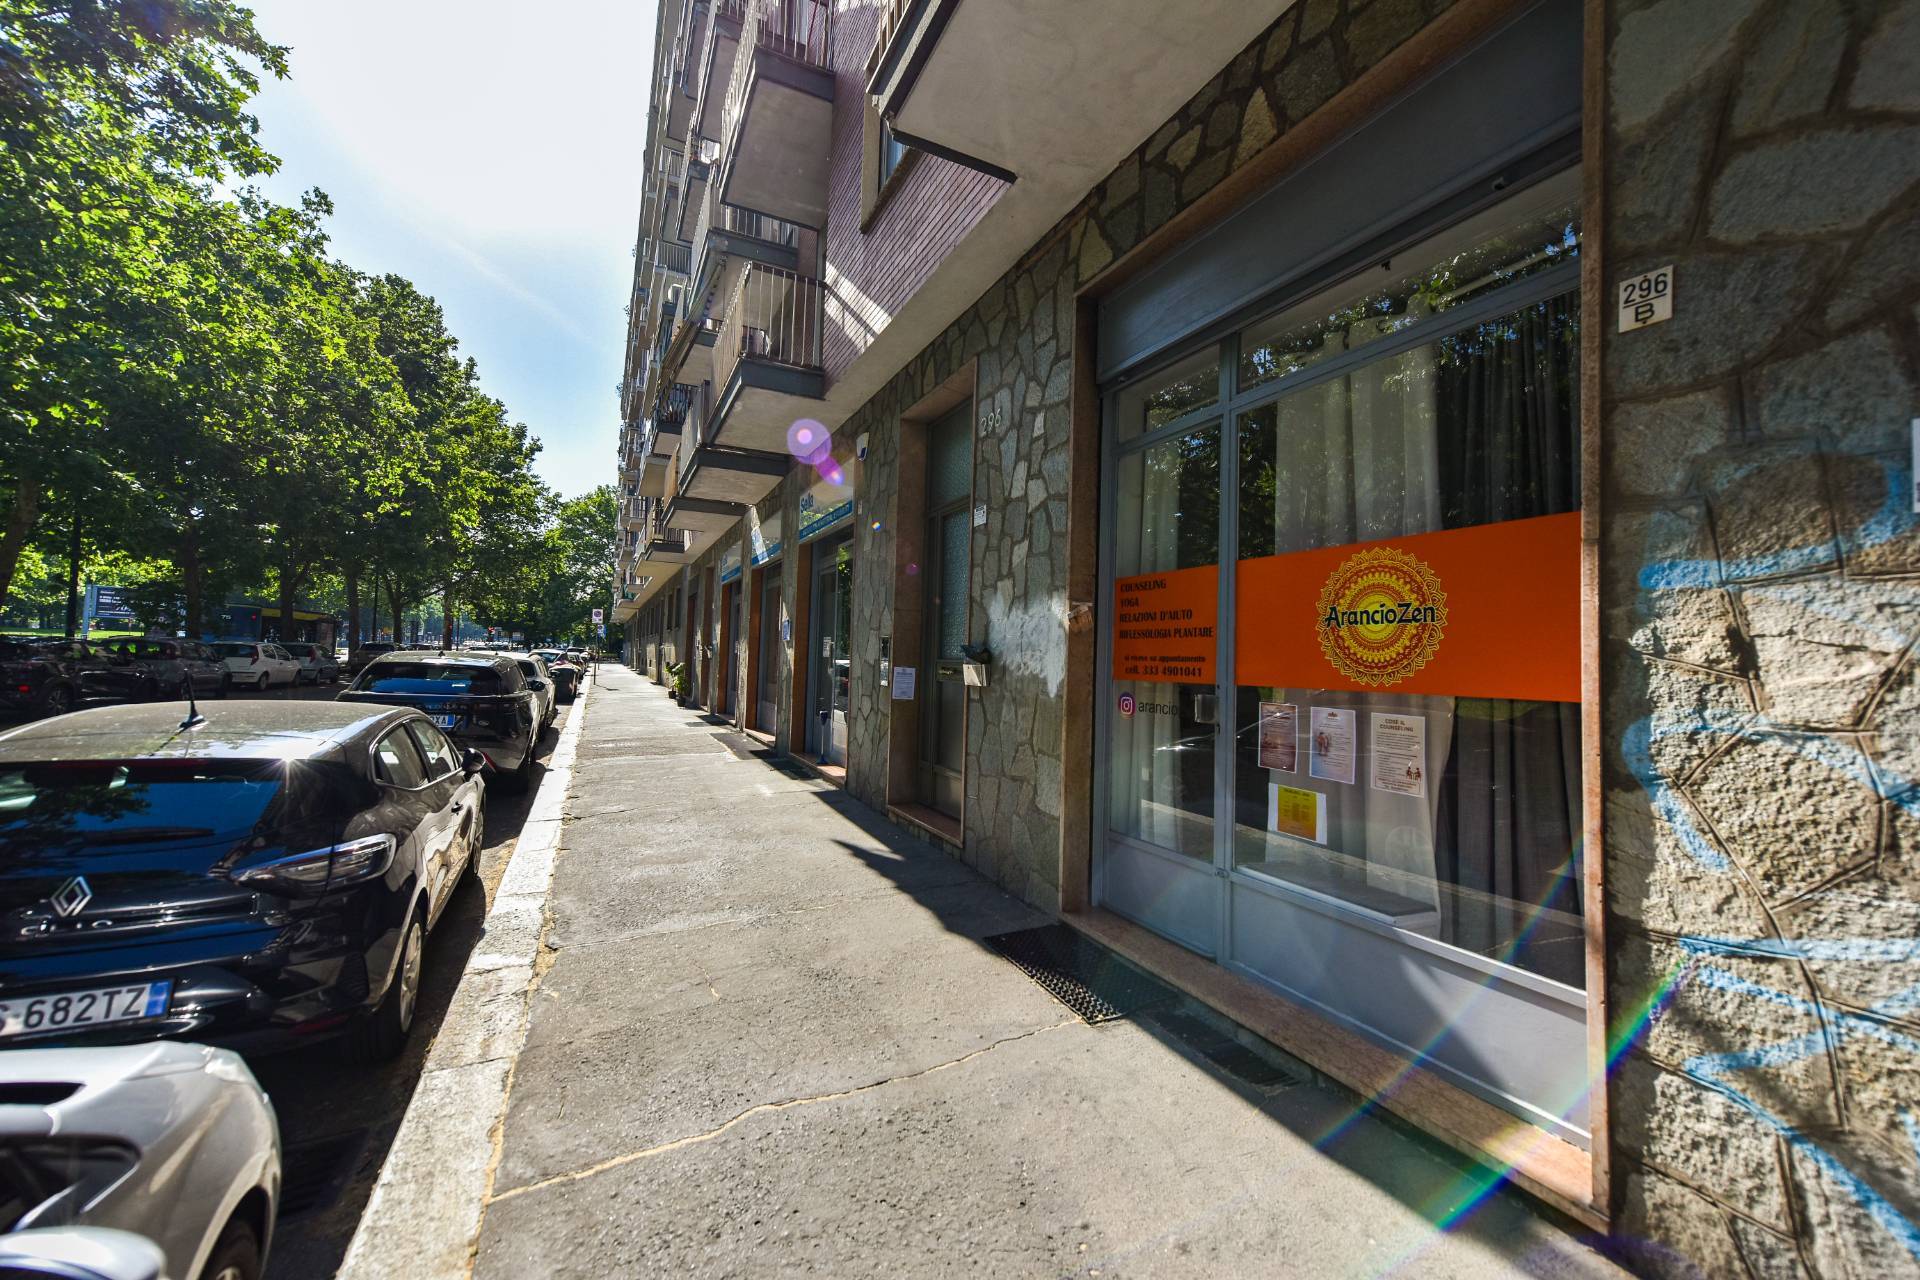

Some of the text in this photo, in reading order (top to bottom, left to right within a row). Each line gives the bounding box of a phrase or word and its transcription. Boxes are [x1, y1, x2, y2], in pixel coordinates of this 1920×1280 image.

[1623, 272, 1668, 305] 296
[1634, 302, 1655, 323] B
[980, 408, 1002, 434] 296
[1120, 578, 1167, 593] COUNSELING
[1120, 597, 1139, 608] YOGA
[1119, 608, 1193, 623] RELAZIONI D'AIUTO
[1325, 602, 1437, 628] ArancioZen
[1119, 626, 1213, 640] RIFLESSOLOGIA PLANTARE
[1142, 665, 1159, 676] 333
[1162, 665, 1202, 678] 4901041
[1379, 724, 1414, 733] COUNSELING
